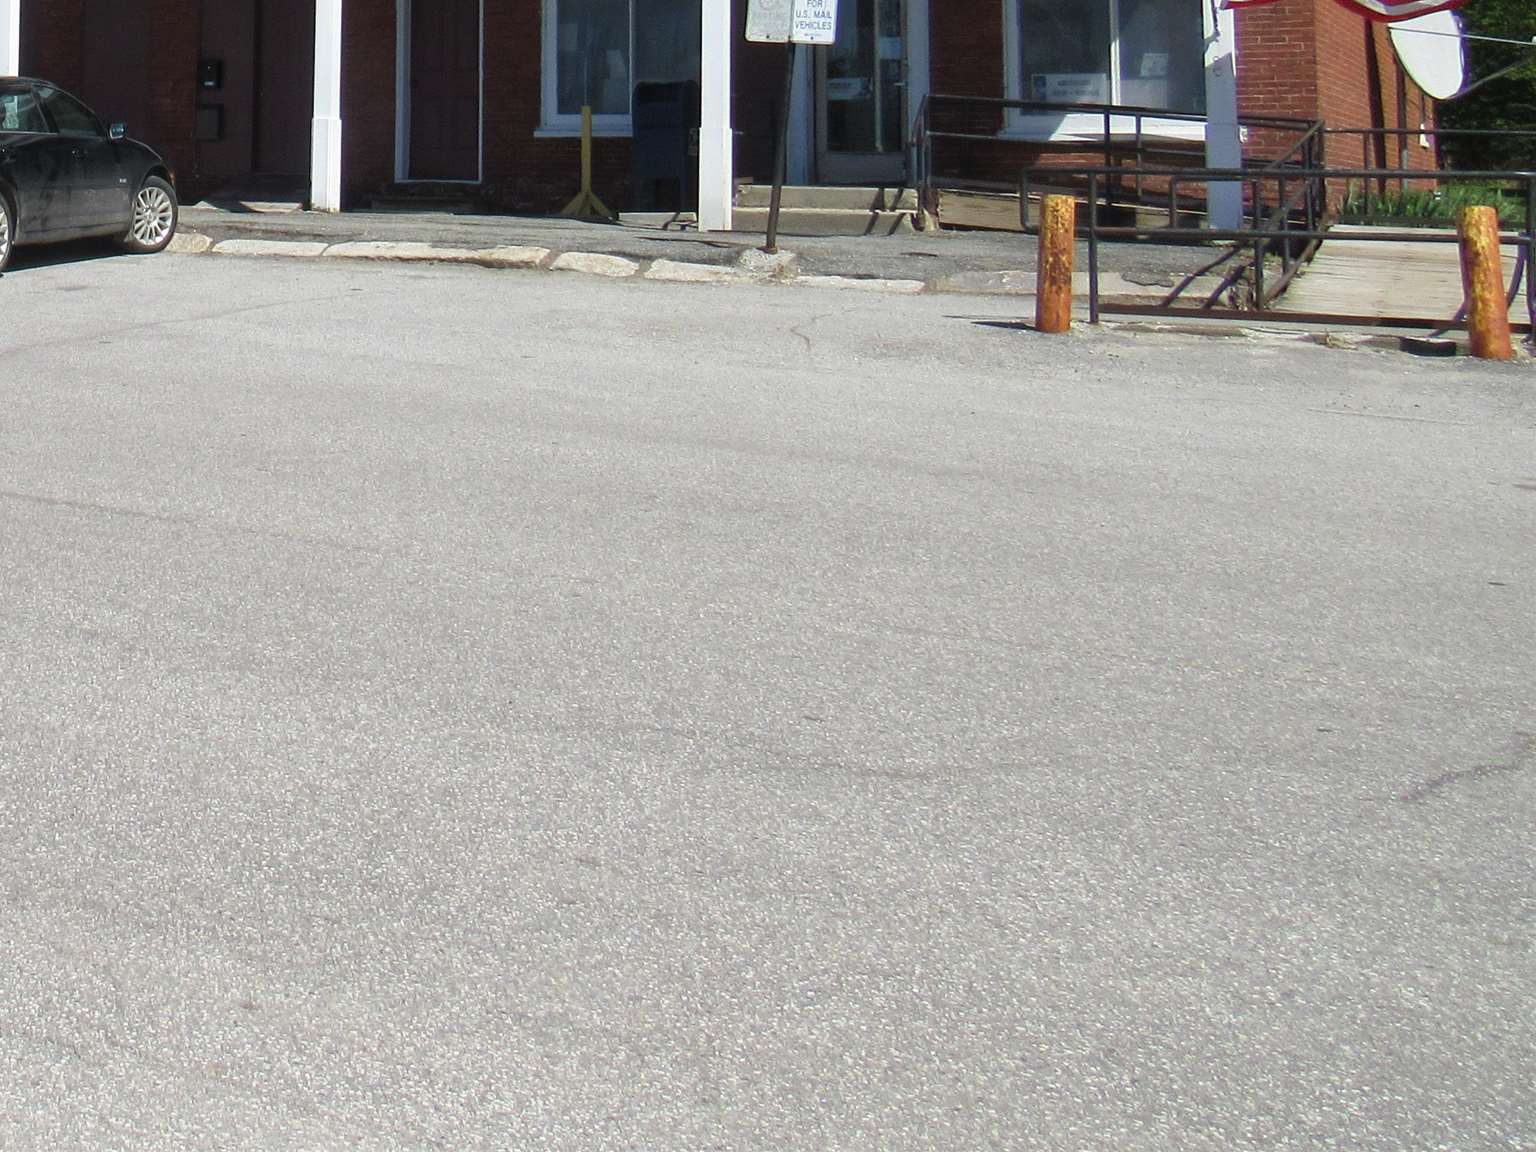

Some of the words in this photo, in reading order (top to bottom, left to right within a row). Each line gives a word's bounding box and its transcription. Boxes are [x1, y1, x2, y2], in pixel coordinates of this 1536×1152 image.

[807, 0, 823, 8] FOR
[813, 10, 832, 19] MAIL
[794, 21, 832, 31] VEHICLES
